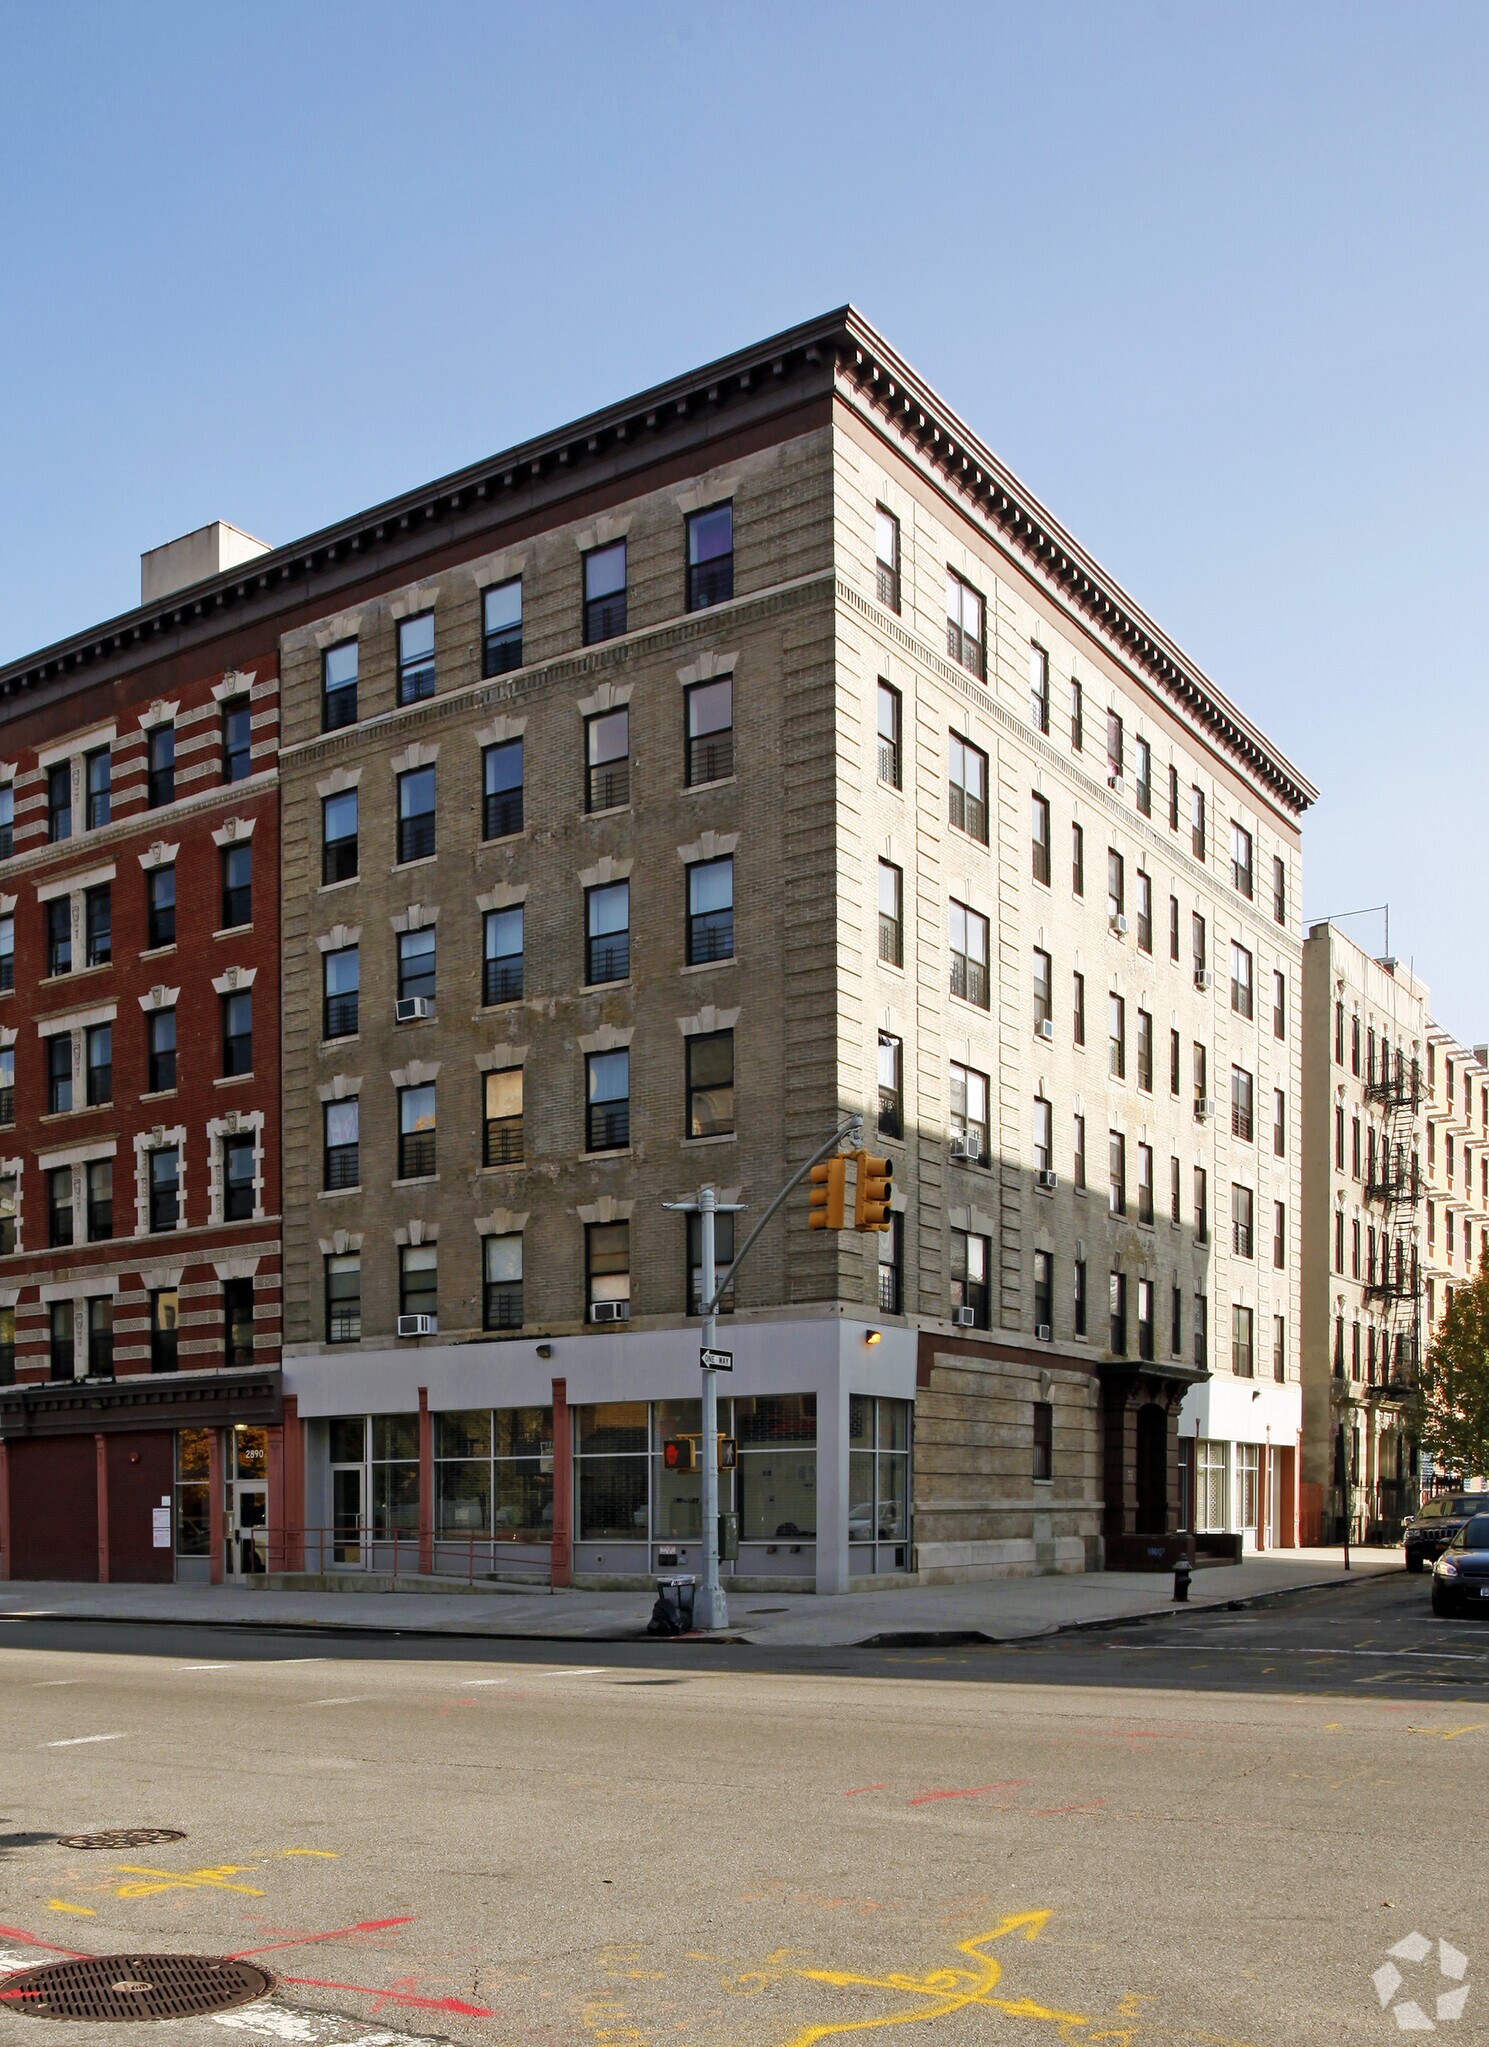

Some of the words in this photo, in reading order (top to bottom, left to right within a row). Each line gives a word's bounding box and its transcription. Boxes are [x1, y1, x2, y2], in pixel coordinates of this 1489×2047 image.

[704, 1354, 715, 1364] ONE
[718, 1356, 729, 1365] WAY
[245, 1449, 264, 1459] 2890
